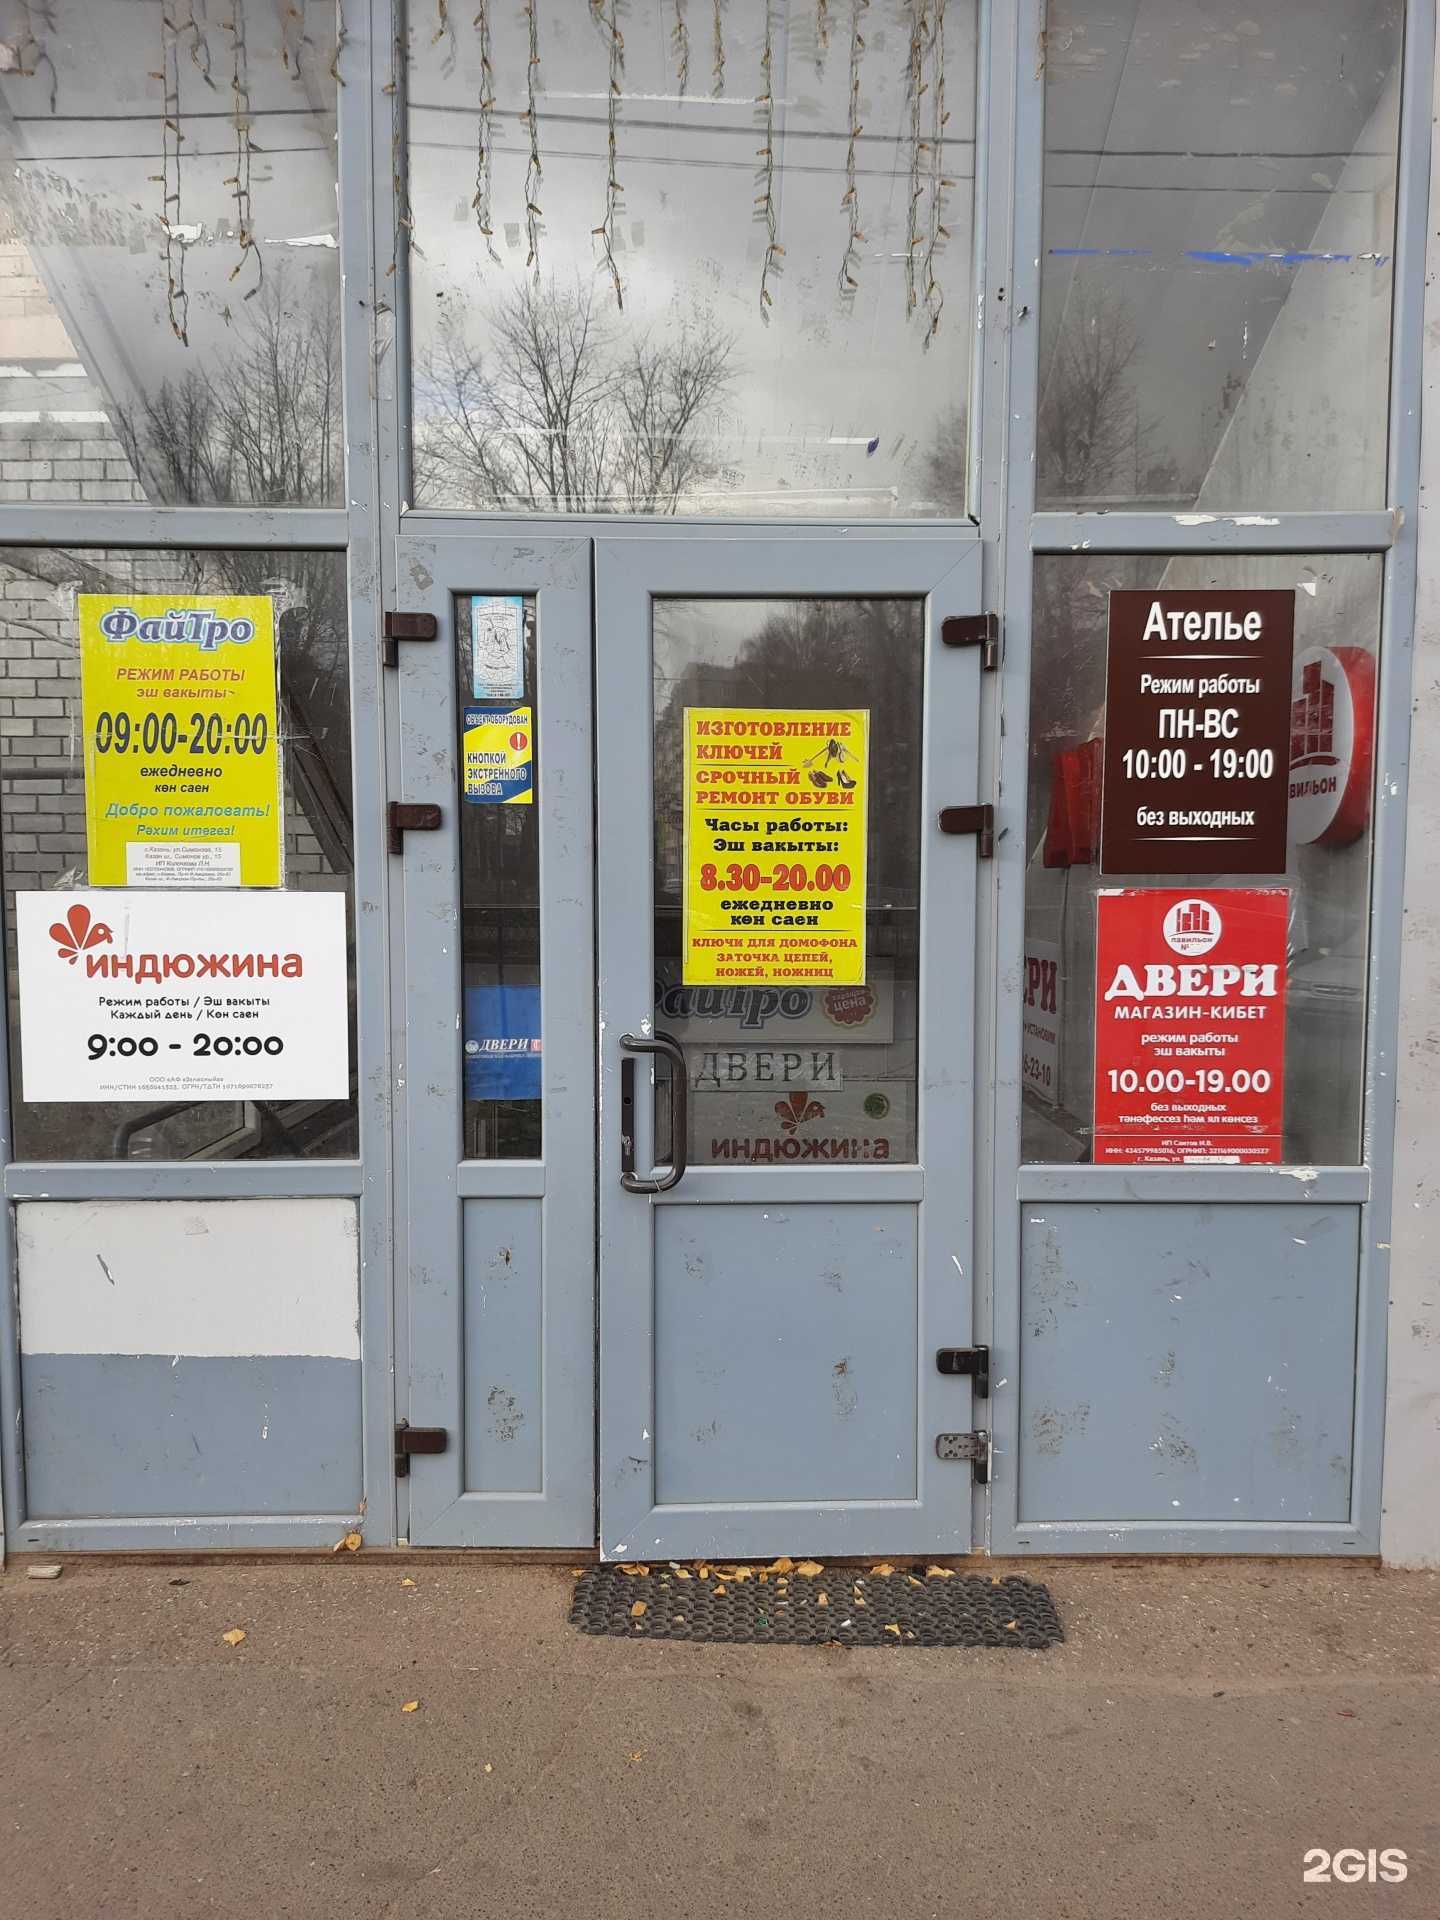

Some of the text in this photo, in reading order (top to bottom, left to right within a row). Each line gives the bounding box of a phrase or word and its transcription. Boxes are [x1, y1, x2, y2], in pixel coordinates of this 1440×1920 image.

[1142, 602, 1262, 641] Ателье
[101, 608, 255, 651] ФайТро
[116, 667, 245, 682] РЕЖИМ РАБОТЫ
[1140, 674, 1260, 698] Режим работы
[137, 689, 160, 699] эш
[697, 721, 851, 736] ИЗГОТОВЛЕНИЕ
[1158, 708, 1239, 739] ПН-ВС
[95, 711, 268, 755] 09:00-20:00
[467, 752, 506, 763] КНОПКОЙ
[697, 742, 782, 760] КЛЮЧЕЙ
[140, 764, 223, 779] ежедневно
[1122, 749, 1186, 779] 10:00
[1209, 749, 1273, 779] 19:00
[467, 769, 527, 779] ЭКСТРЕННОГО
[696, 769, 800, 784] СРОЧНЫЙ
[154, 782, 209, 793] көн саен
[468, 784, 502, 794] ВЫЗОВА
[696, 791, 853, 804] РЕМОНТ ОБУВИ
[105, 803, 270, 818] Добро пожаловать!
[1137, 807, 1255, 828] без выходных
[705, 818, 848, 834] Часы работы:
[713, 839, 839, 851] Эш вакыты:
[700, 864, 850, 891] 8.30-20.00
[720, 901, 834, 911] ежедневно
[731, 915, 818, 925] көн саен
[692, 938, 857, 948] КЛЮЧИ ДЛЯ ДОМОФОНА
[717, 953, 832, 964] ЗАТОЧКА ЦЕПЕЙ,
[86, 953, 303, 984] индюжина
[716, 968, 833, 978] НОЖЕЙ, НОЖНИЦ
[1104, 964, 1278, 1001] ДВЕРИ
[99, 996, 270, 1009] Режим работы / Эш вакыты
[833, 996, 866, 1012] цена
[110, 1009, 259, 1022] Каждый день / Көн саен
[1114, 1006, 1267, 1019] МАГАЗИН-КИБЕТ
[479, 1039, 528, 1051] ДВЕРИ
[1141, 1032, 1238, 1045] режим работы
[87, 1034, 159, 1061] 9:00
[193, 1033, 284, 1056] 20:00
[1154, 1047, 1225, 1056] эш вакыты
[695, 1052, 835, 1087] ДВЕРИ
[1107, 1069, 1271, 1093] 10.00-19.00
[1151, 1102, 1226, 1112] без выходных
[1208, 1115, 1220, 1124] ял
